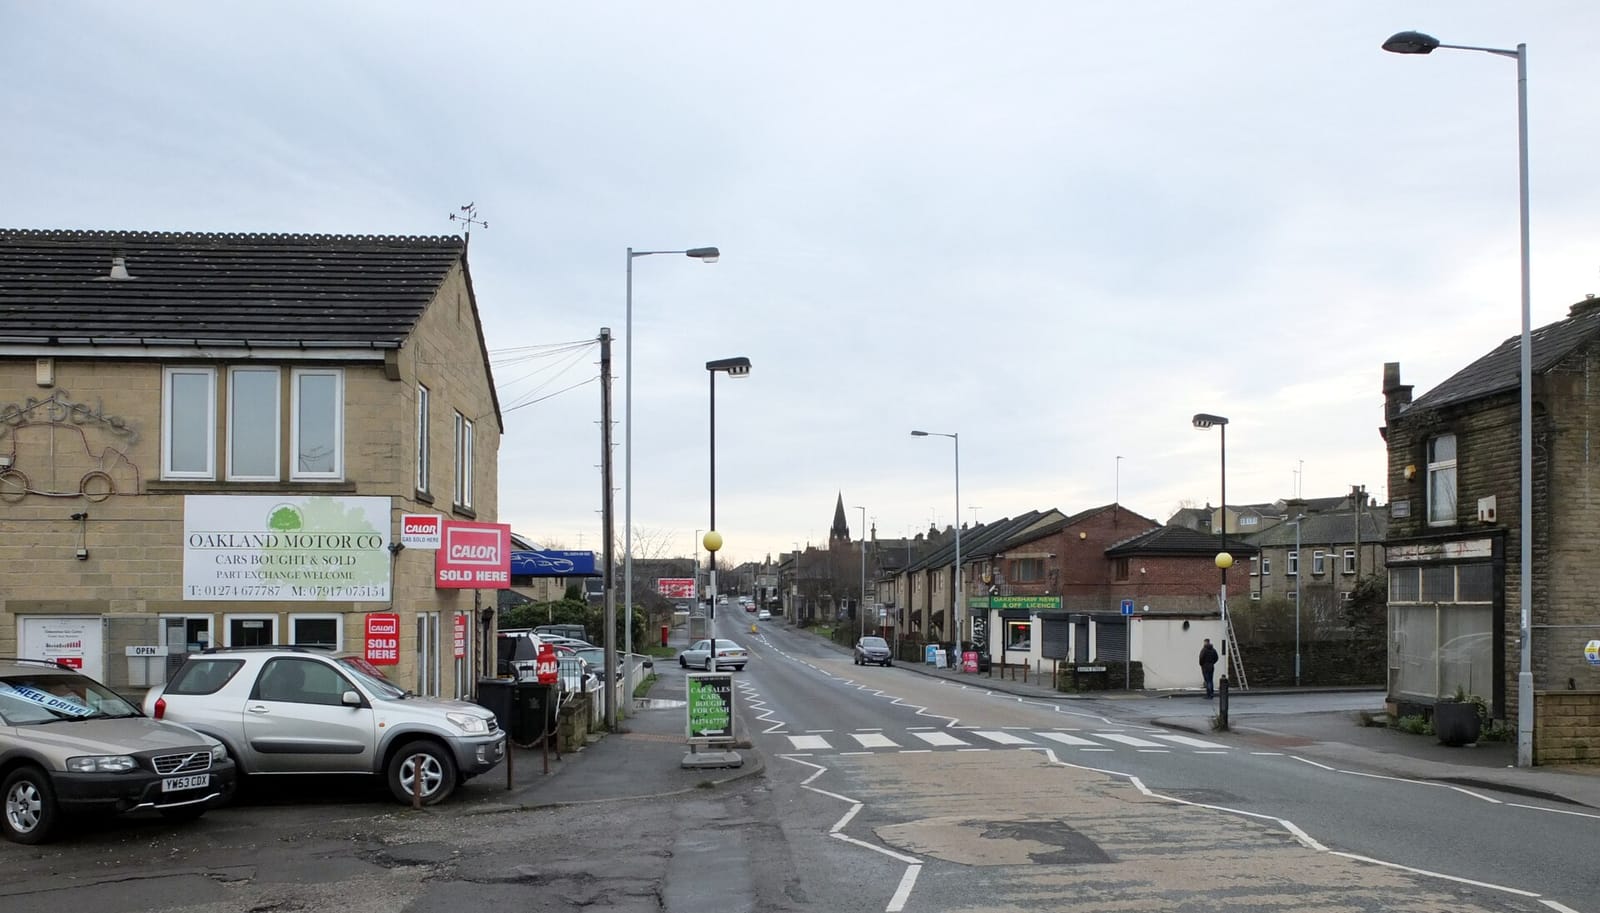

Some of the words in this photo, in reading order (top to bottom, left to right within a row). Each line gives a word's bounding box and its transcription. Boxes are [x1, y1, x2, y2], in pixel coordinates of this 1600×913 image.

[405, 524, 437, 535] CALOR
[189, 533, 279, 548] OAKLAND
[284, 534, 352, 548] MOTOR
[356, 535, 383, 549] CO
[452, 544, 497, 562] CALOR
[215, 554, 248, 565] CARS
[251, 554, 307, 565] BOUGHT
[310, 555, 318, 565] &
[322, 555, 356, 565] SOLD
[216, 570, 241, 579] PART
[244, 570, 301, 580] EXCHANGE
[303, 571, 355, 580] WELCOME
[439, 569, 473, 581] SOLD
[476, 571, 508, 582] HERE
[188, 585, 202, 596] T:
[204, 585, 237, 596] 01274
[241, 585, 281, 596] 677787
[292, 586, 306, 597] M:
[309, 586, 343, 597] 07917
[345, 586, 385, 597] 075154
[371, 625, 394, 633] CALOR
[367, 639, 397, 649] SOLD
[135, 647, 156, 655] OPEN
[367, 650, 397, 660] HERE
[191, 775, 207, 787] CDX
